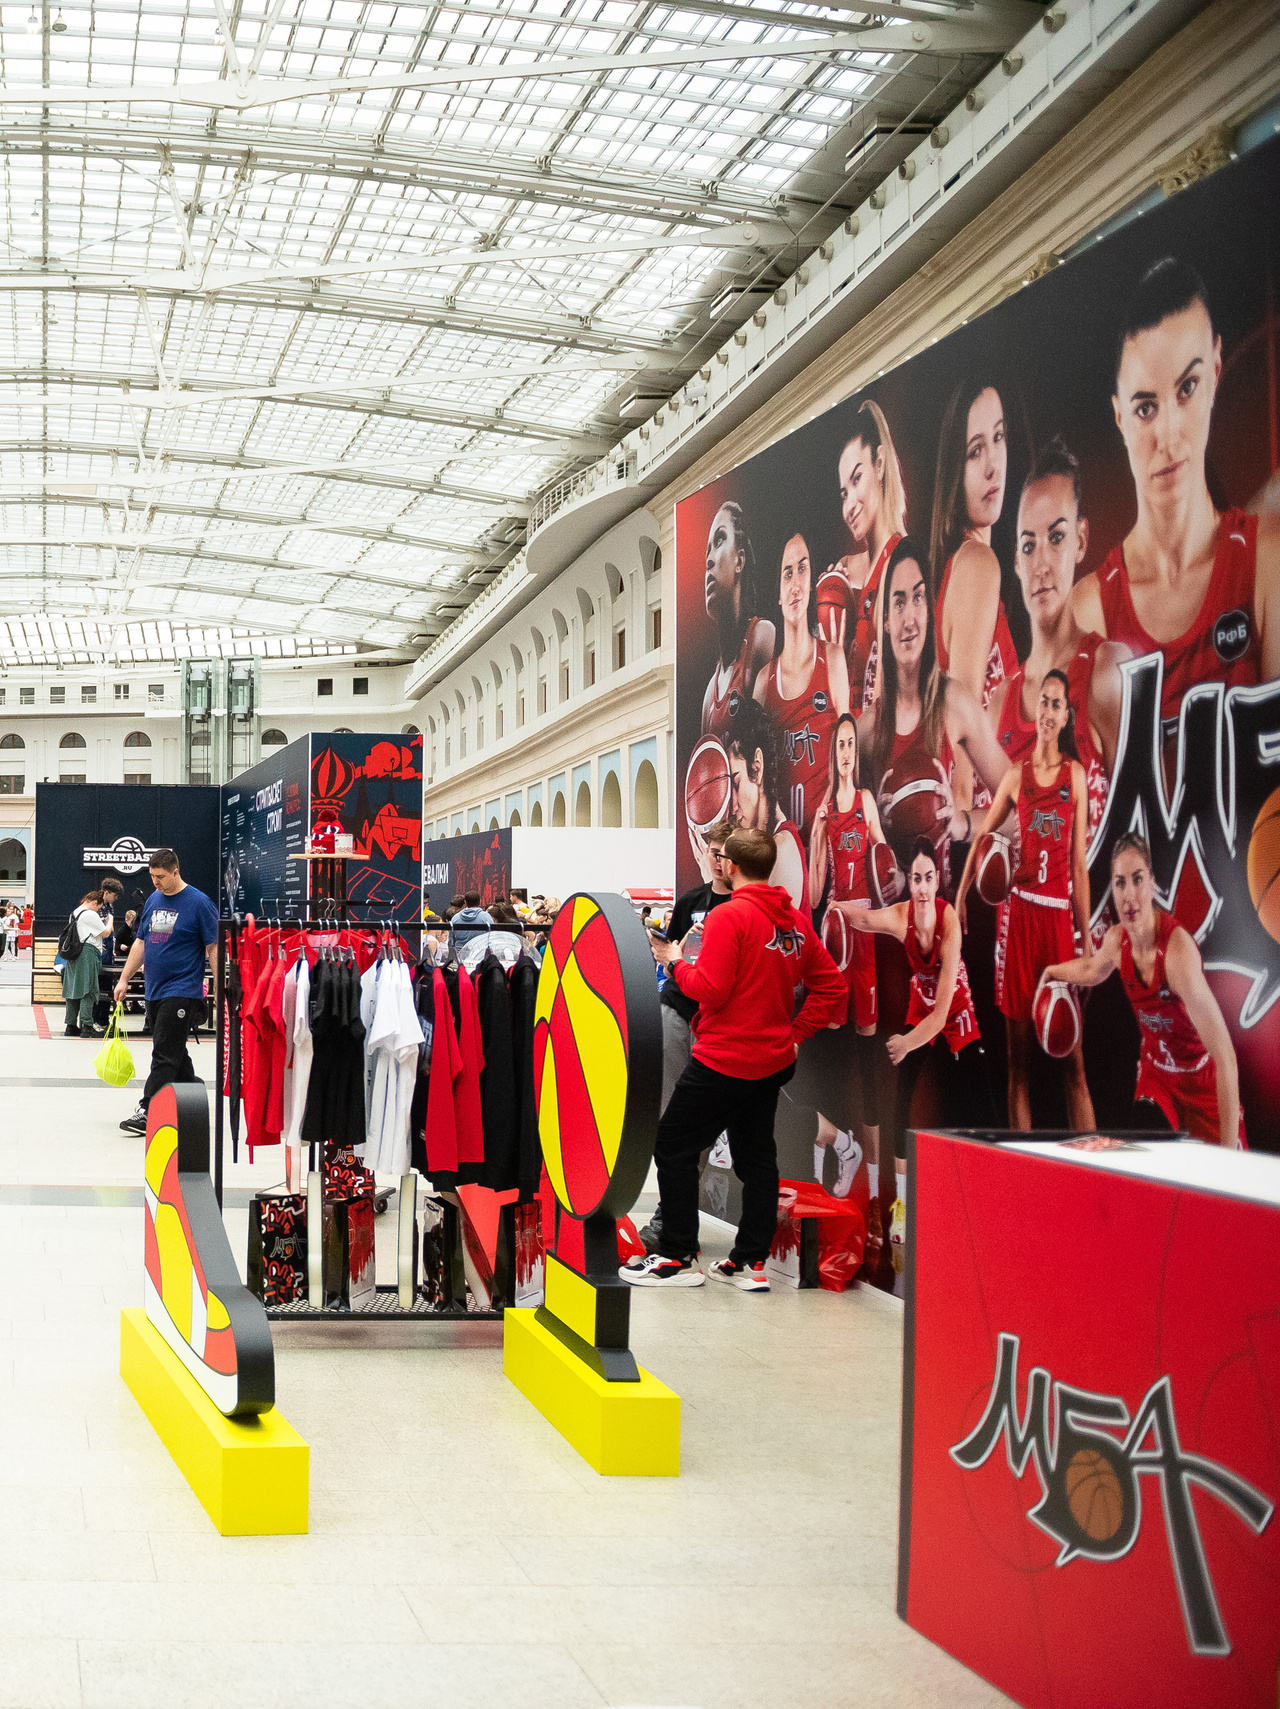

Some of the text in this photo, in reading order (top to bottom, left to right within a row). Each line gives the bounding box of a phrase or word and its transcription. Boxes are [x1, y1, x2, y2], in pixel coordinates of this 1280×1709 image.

[1217, 624, 1247, 645] РФБ
[83, 852, 152, 862] STREETBAS
[1038, 850, 1048, 884] 3
[424, 863, 449, 885] ЕВАЛКИ
[948, 1331, 1275, 1657] МБА
